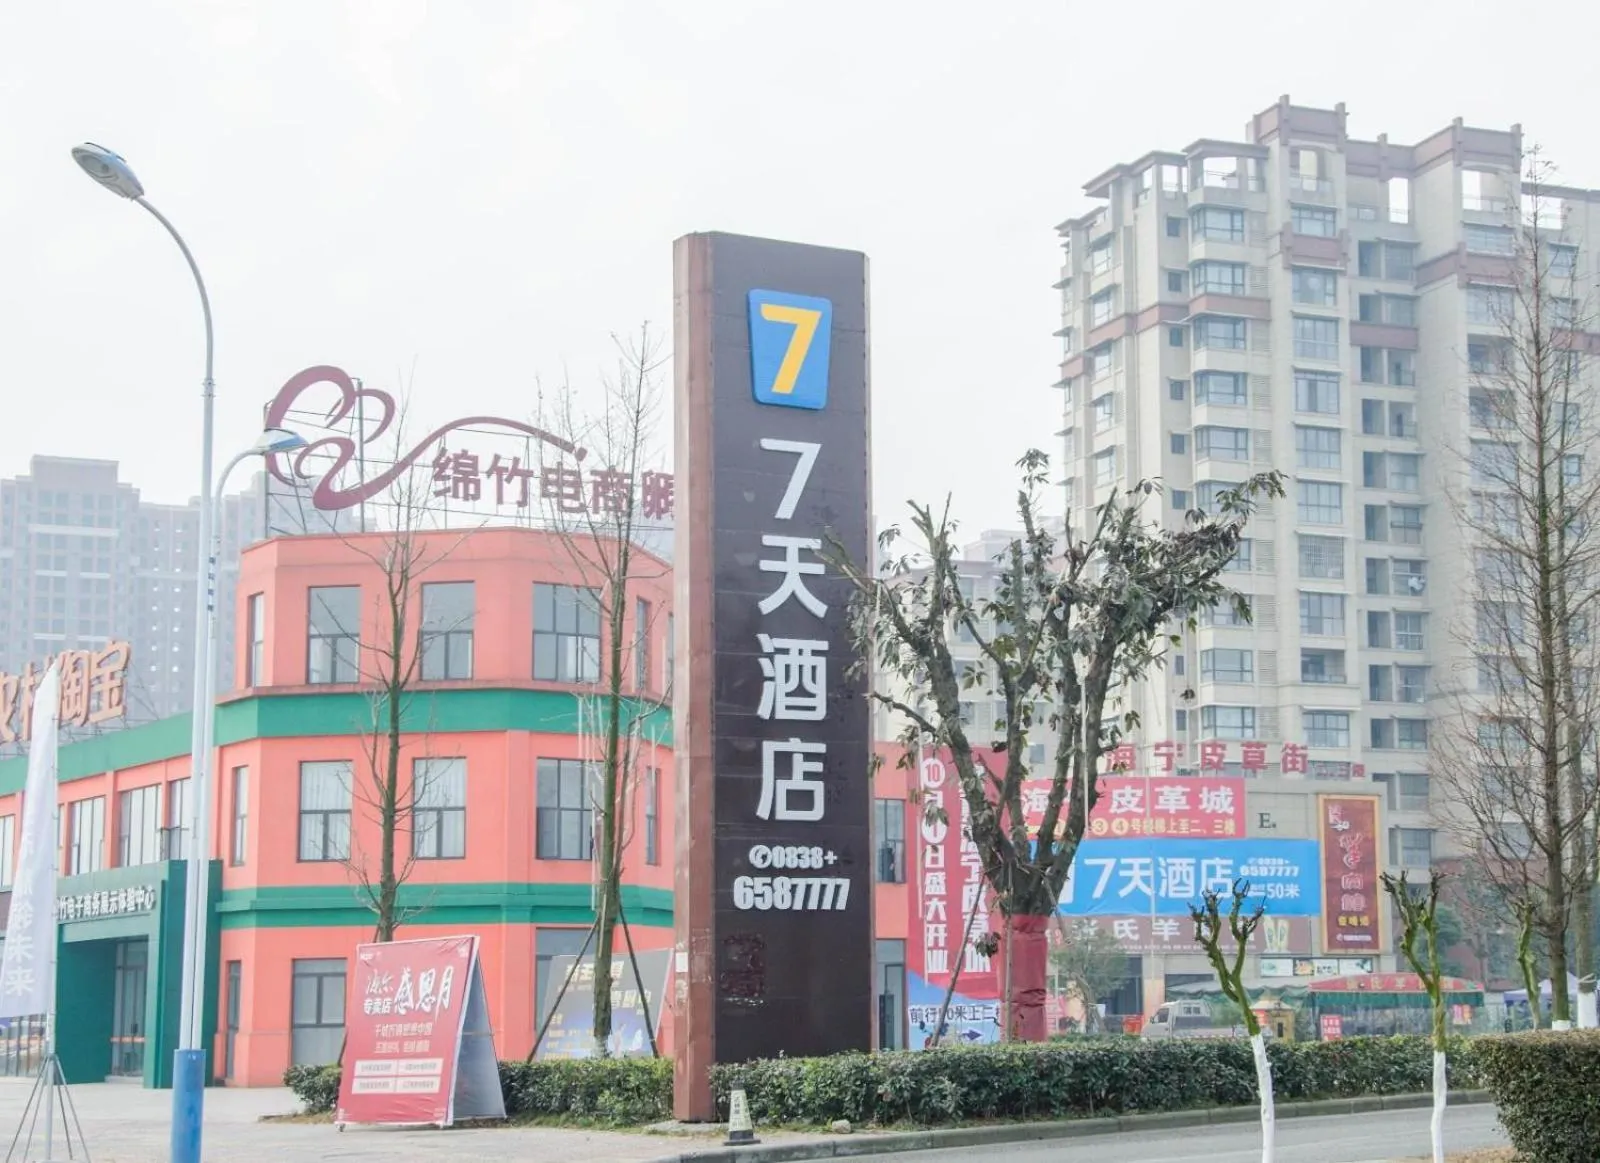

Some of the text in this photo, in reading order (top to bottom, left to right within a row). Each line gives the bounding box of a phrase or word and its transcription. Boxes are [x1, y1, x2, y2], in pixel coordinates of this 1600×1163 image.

[761, 303, 822, 395] 7
[756, 438, 829, 821] 7天酒店
[1023, 786, 1234, 814] 海皮革城
[733, 876, 850, 911] 6587777
[1084, 857, 1235, 899] 7天酒店
[57, 885, 155, 920] 竹电子商务展示体验中心
[909, 1004, 1000, 1024] 前行0米上二
